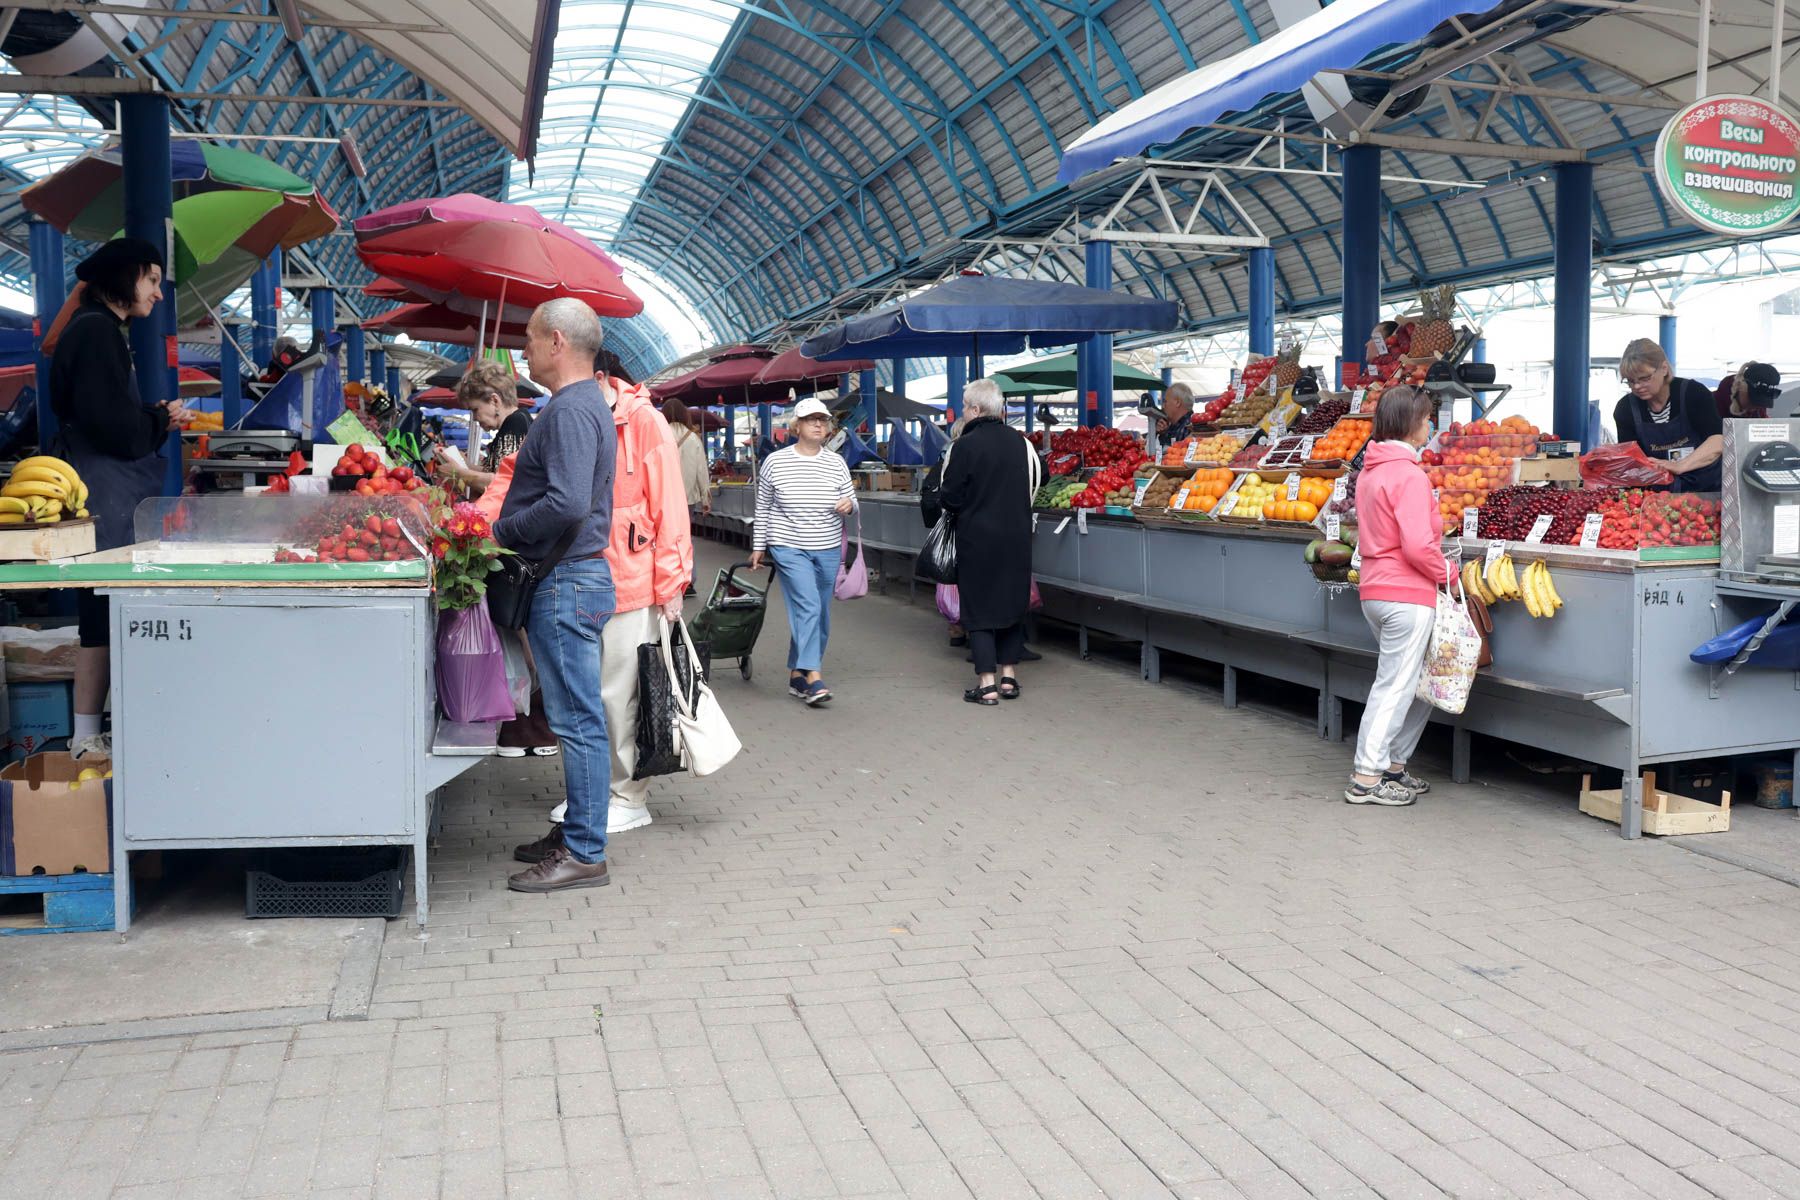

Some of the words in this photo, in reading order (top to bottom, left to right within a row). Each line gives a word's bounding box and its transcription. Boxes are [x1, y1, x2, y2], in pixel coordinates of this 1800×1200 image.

[1721, 120, 1764, 143] Весы
[1684, 145, 1796, 173] контрольного
[1684, 171, 1793, 199] взвешивания
[1644, 590, 1668, 606] РЯД
[1677, 590, 1684, 605] 4
[129, 619, 169, 640] РЯД
[179, 619, 191, 640] 5
